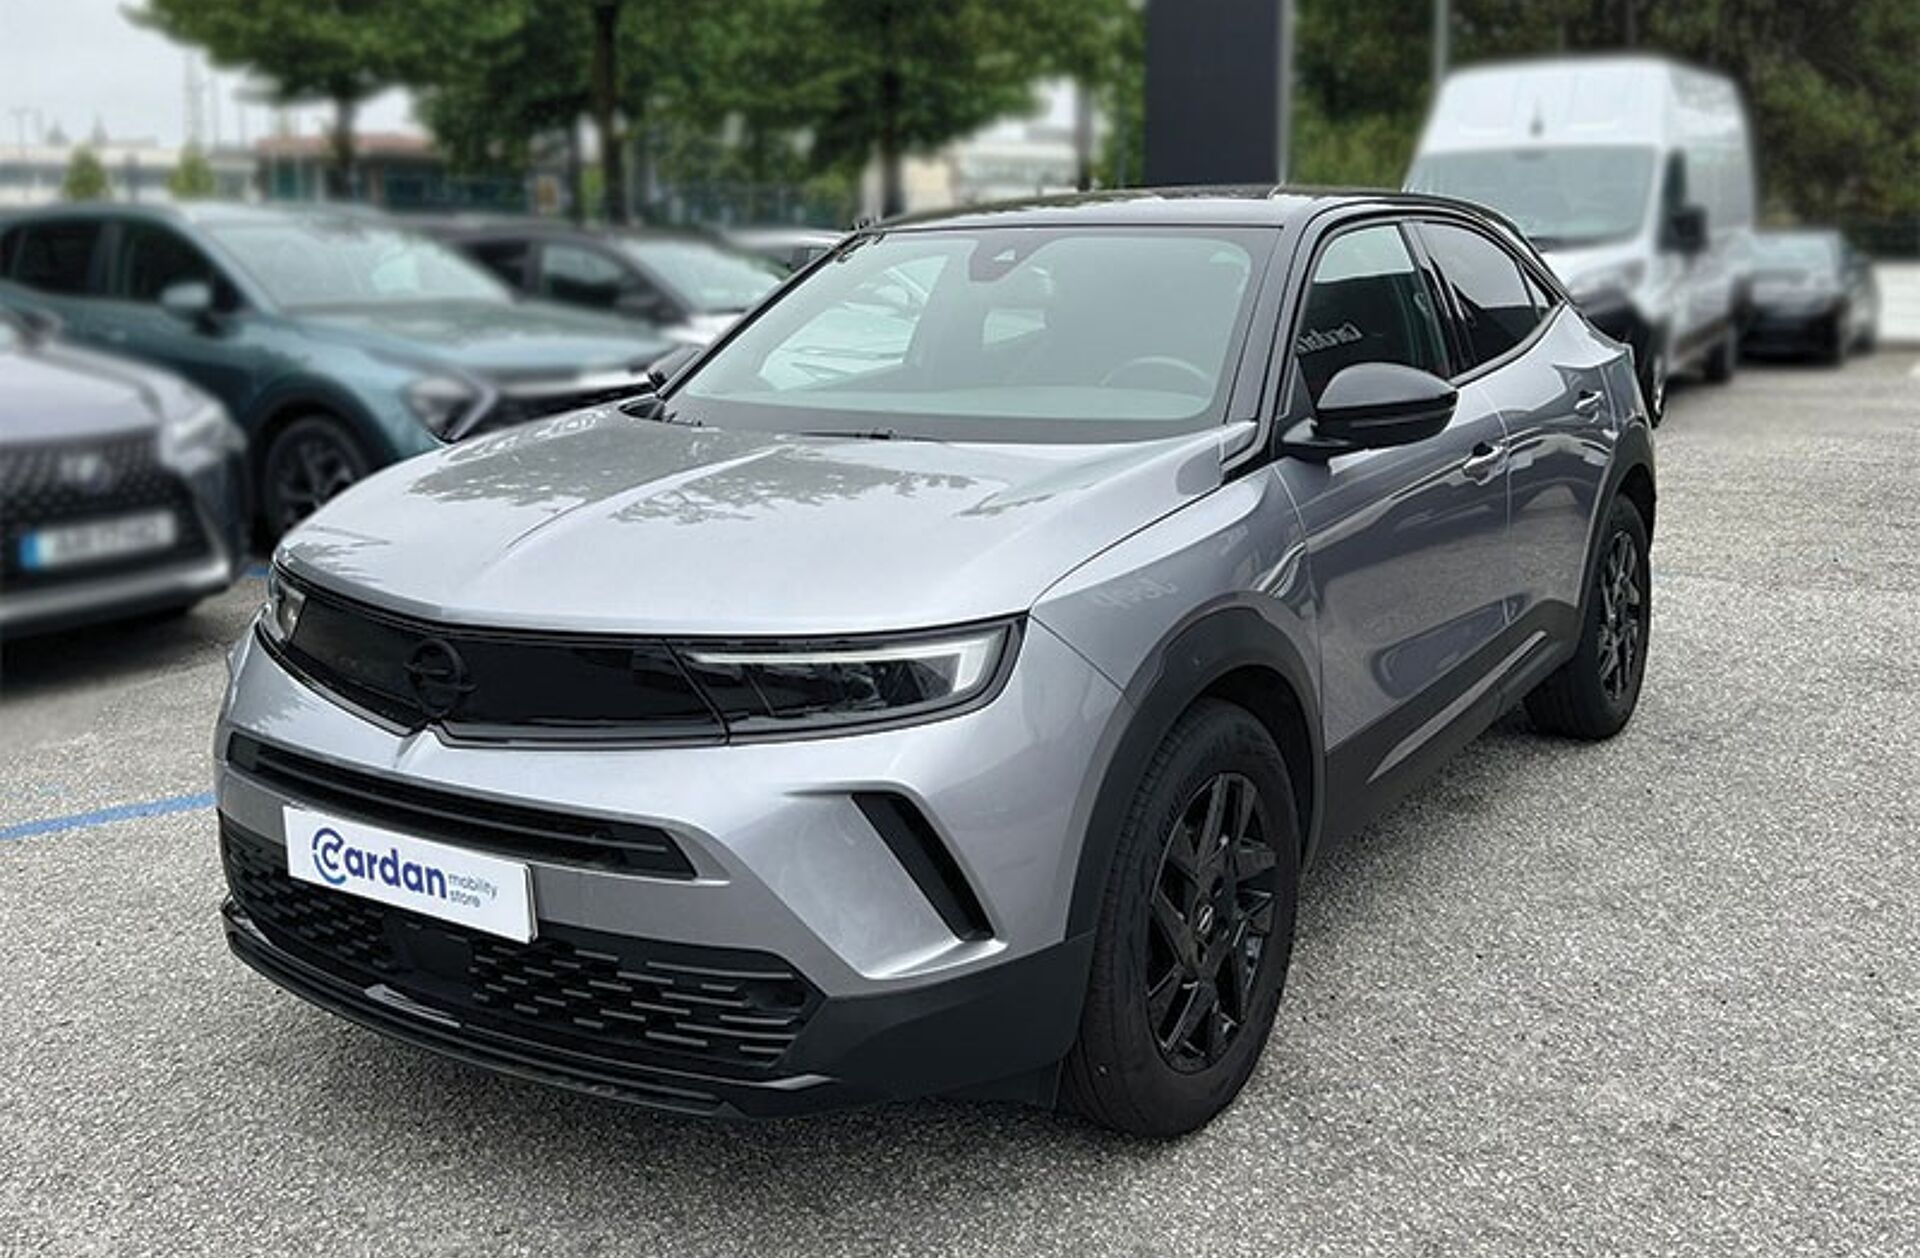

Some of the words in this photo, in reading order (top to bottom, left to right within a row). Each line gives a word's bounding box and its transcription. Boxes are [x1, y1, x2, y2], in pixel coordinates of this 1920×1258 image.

[312, 827, 447, 899] Cardan
[448, 873, 498, 899] mobility
[449, 889, 481, 908] store
